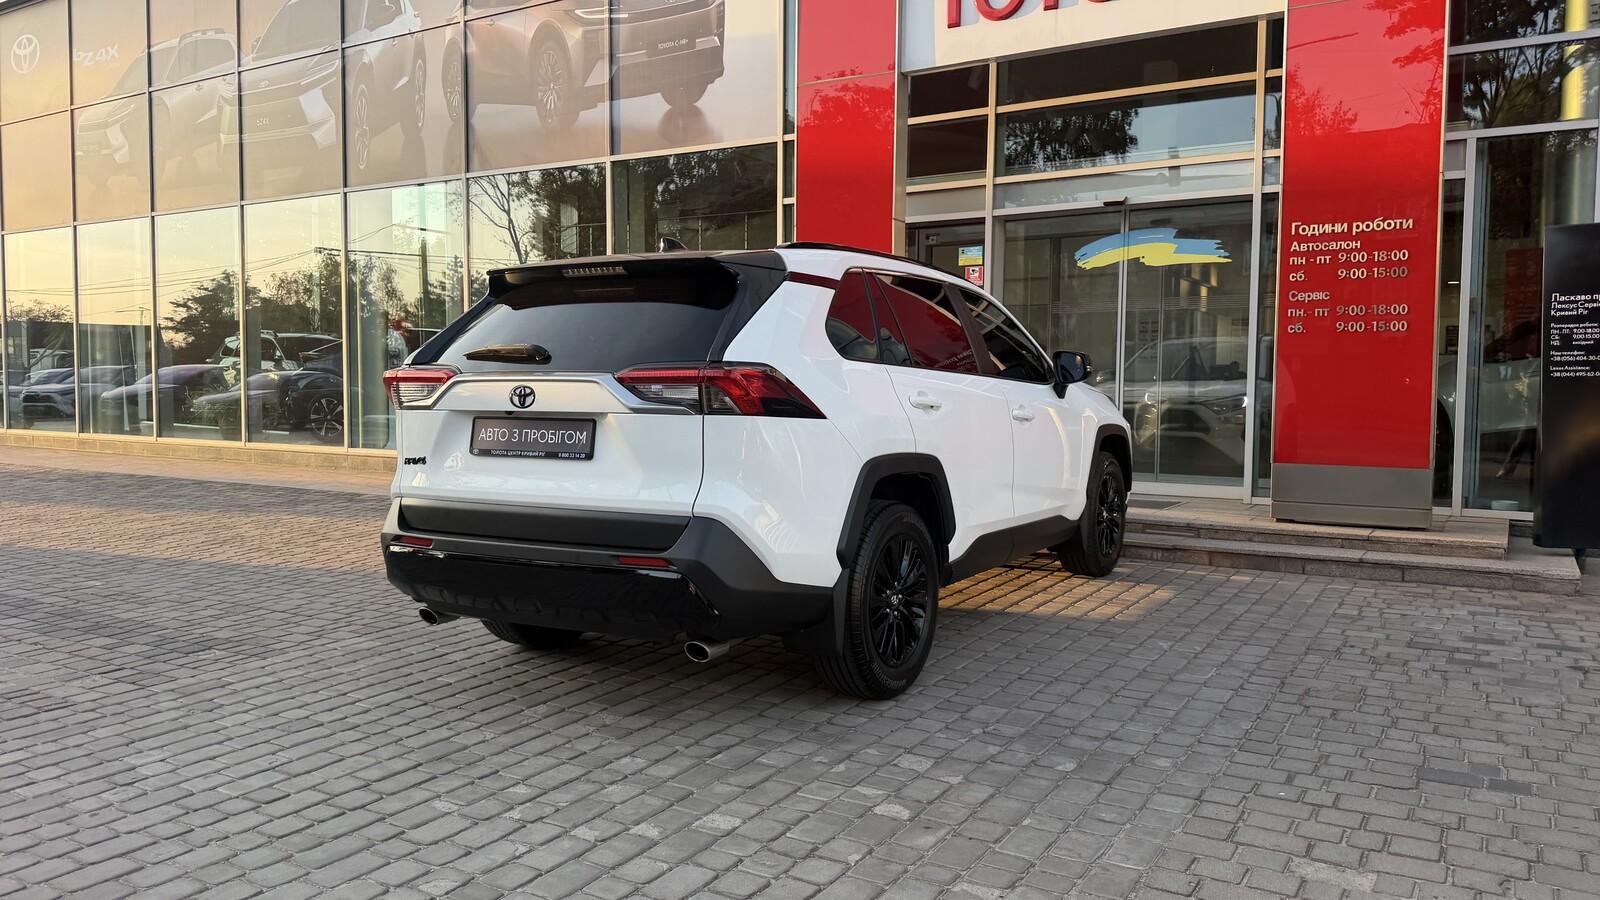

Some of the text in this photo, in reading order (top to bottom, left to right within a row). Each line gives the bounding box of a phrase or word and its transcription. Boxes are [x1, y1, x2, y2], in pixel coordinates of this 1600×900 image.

[1291, 217, 1413, 237] Години роботи
[1290, 240, 1361, 252] Автосалон
[1289, 256, 1306, 265] пн
[1316, 255, 1332, 264] пт
[1289, 270, 1308, 281] сб.
[1289, 290, 1331, 303] Сервіс
[1552, 292, 1592, 302] Ласкаво
[1287, 322, 1307, 333] сб.
[478, 428, 509, 442] АВТО
[522, 429, 587, 444] ПРОБІГОМ
